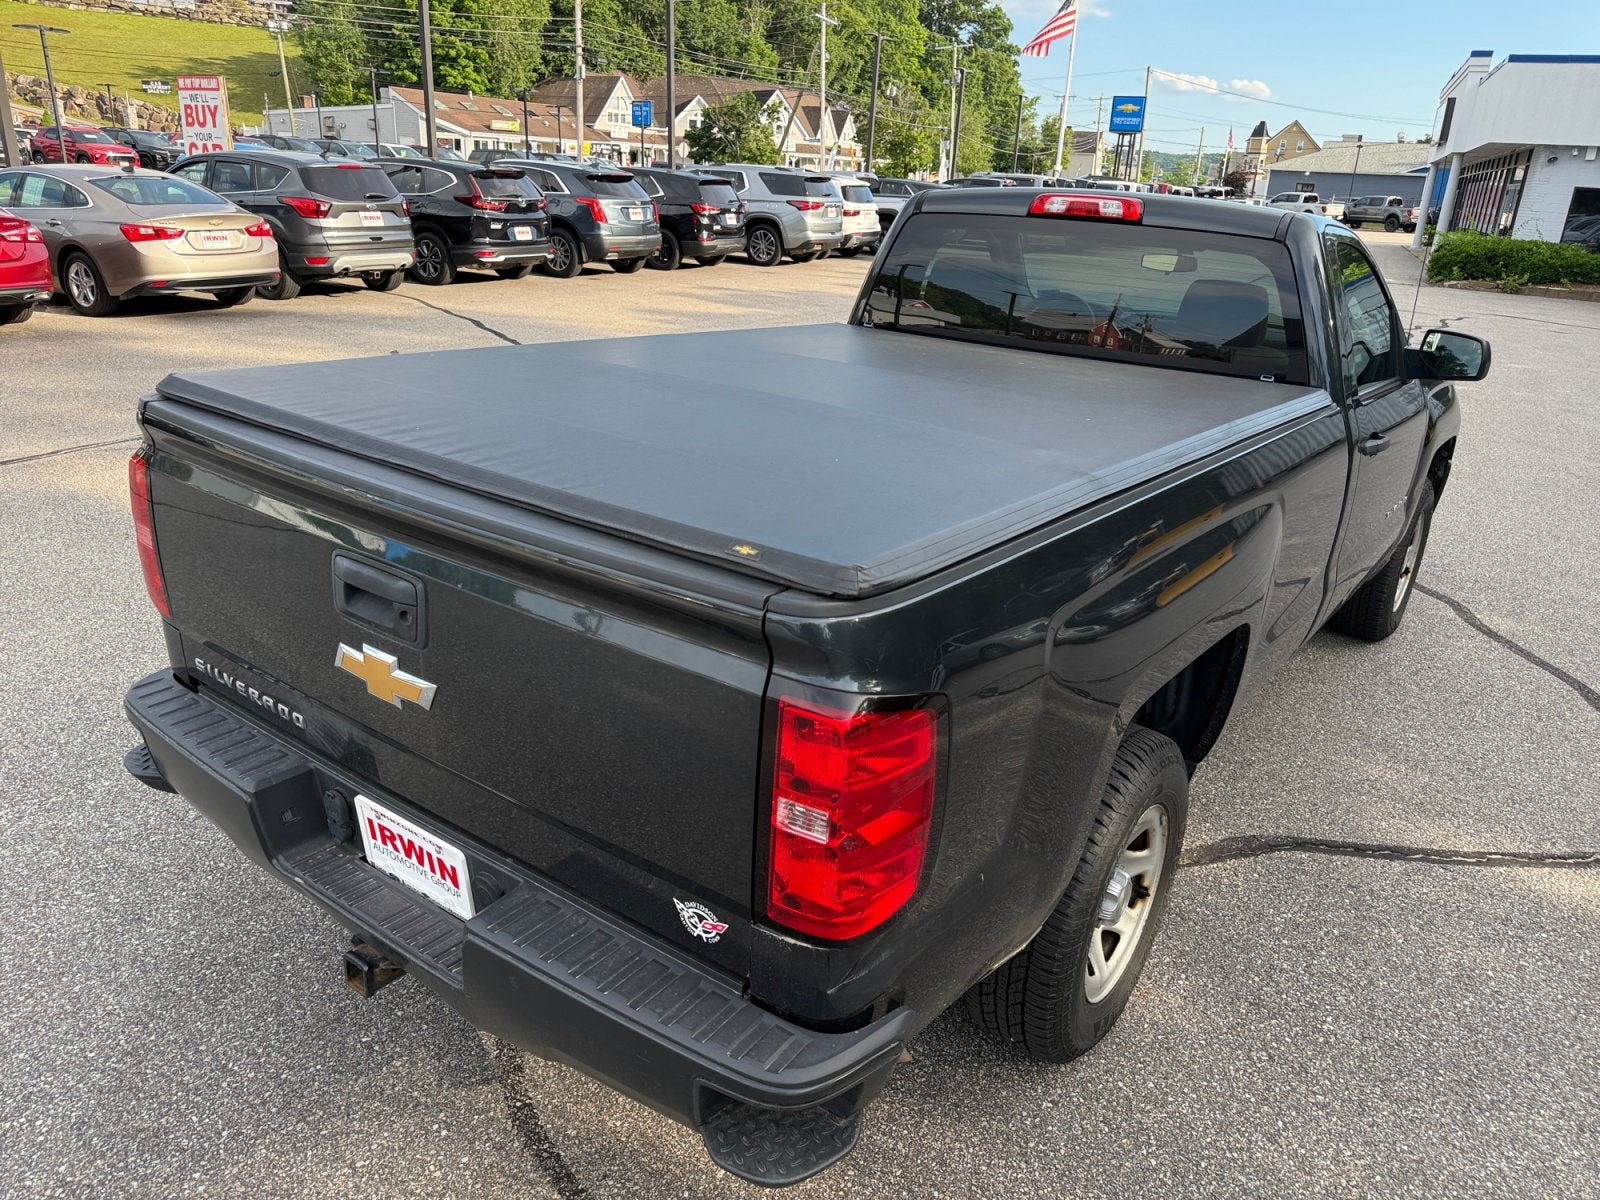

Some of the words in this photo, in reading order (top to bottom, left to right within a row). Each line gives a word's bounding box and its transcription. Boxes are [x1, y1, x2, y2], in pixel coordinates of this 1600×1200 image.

[189, 94, 209, 103] WE'LL
[184, 104, 218, 128] BUY
[194, 132, 213, 141] YOUR
[195, 657, 305, 728] SILVERADO
[366, 816, 461, 891] IRWIN
[373, 841, 430, 880] AUTOMOTIVE
[430, 875, 461, 899] GROUP
[684, 901, 718, 922] DAVIDSON
